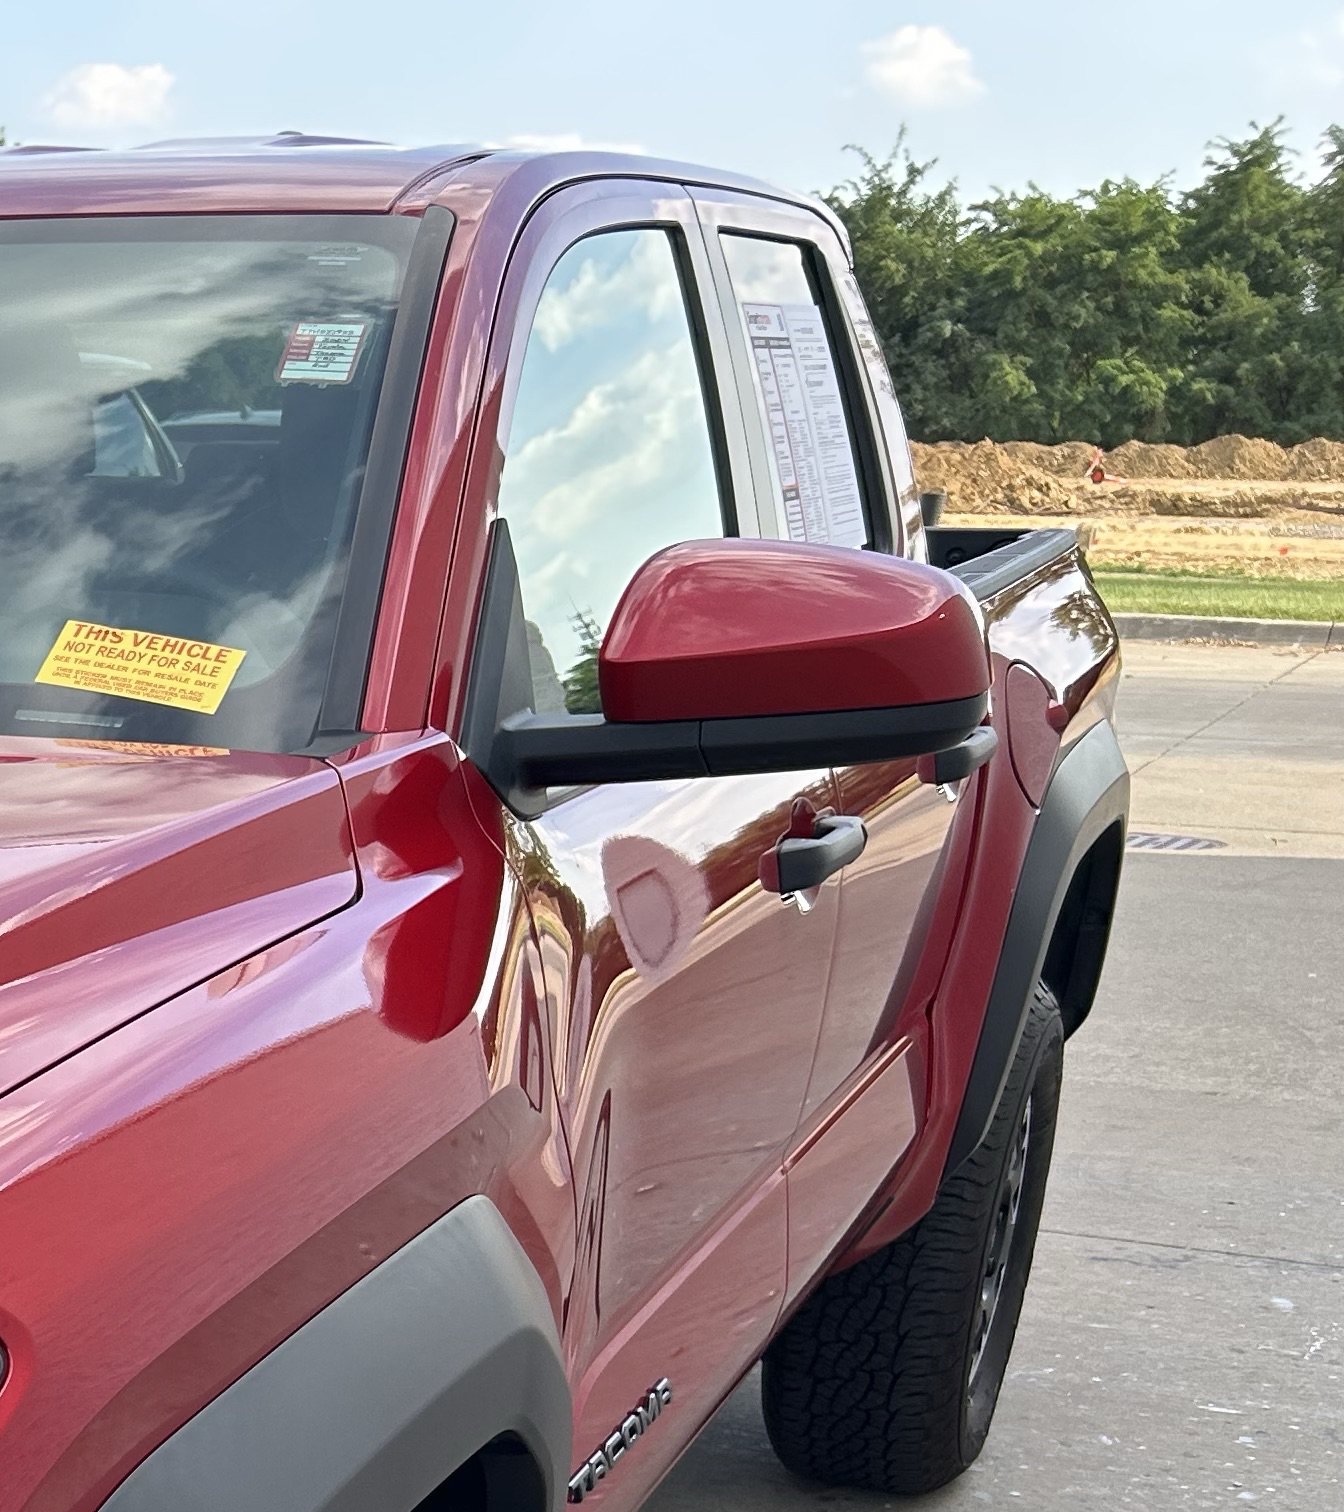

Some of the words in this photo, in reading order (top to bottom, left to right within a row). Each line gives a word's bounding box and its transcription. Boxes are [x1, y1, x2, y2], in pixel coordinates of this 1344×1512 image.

[63, 640, 93, 655] NOT
[96, 645, 146, 663] READY
[148, 654, 179, 669] FOR
[181, 661, 222, 678] SALE
[73, 623, 124, 643] THIS
[133, 633, 231, 663] VEHICLE
[53, 654, 69, 663] SEE
[73, 657, 91, 666] THE
[93, 660, 129, 673] DEALER
[132, 666, 152, 676] FOR
[154, 670, 191, 684] RESALE
[193, 678, 219, 690] DATE
